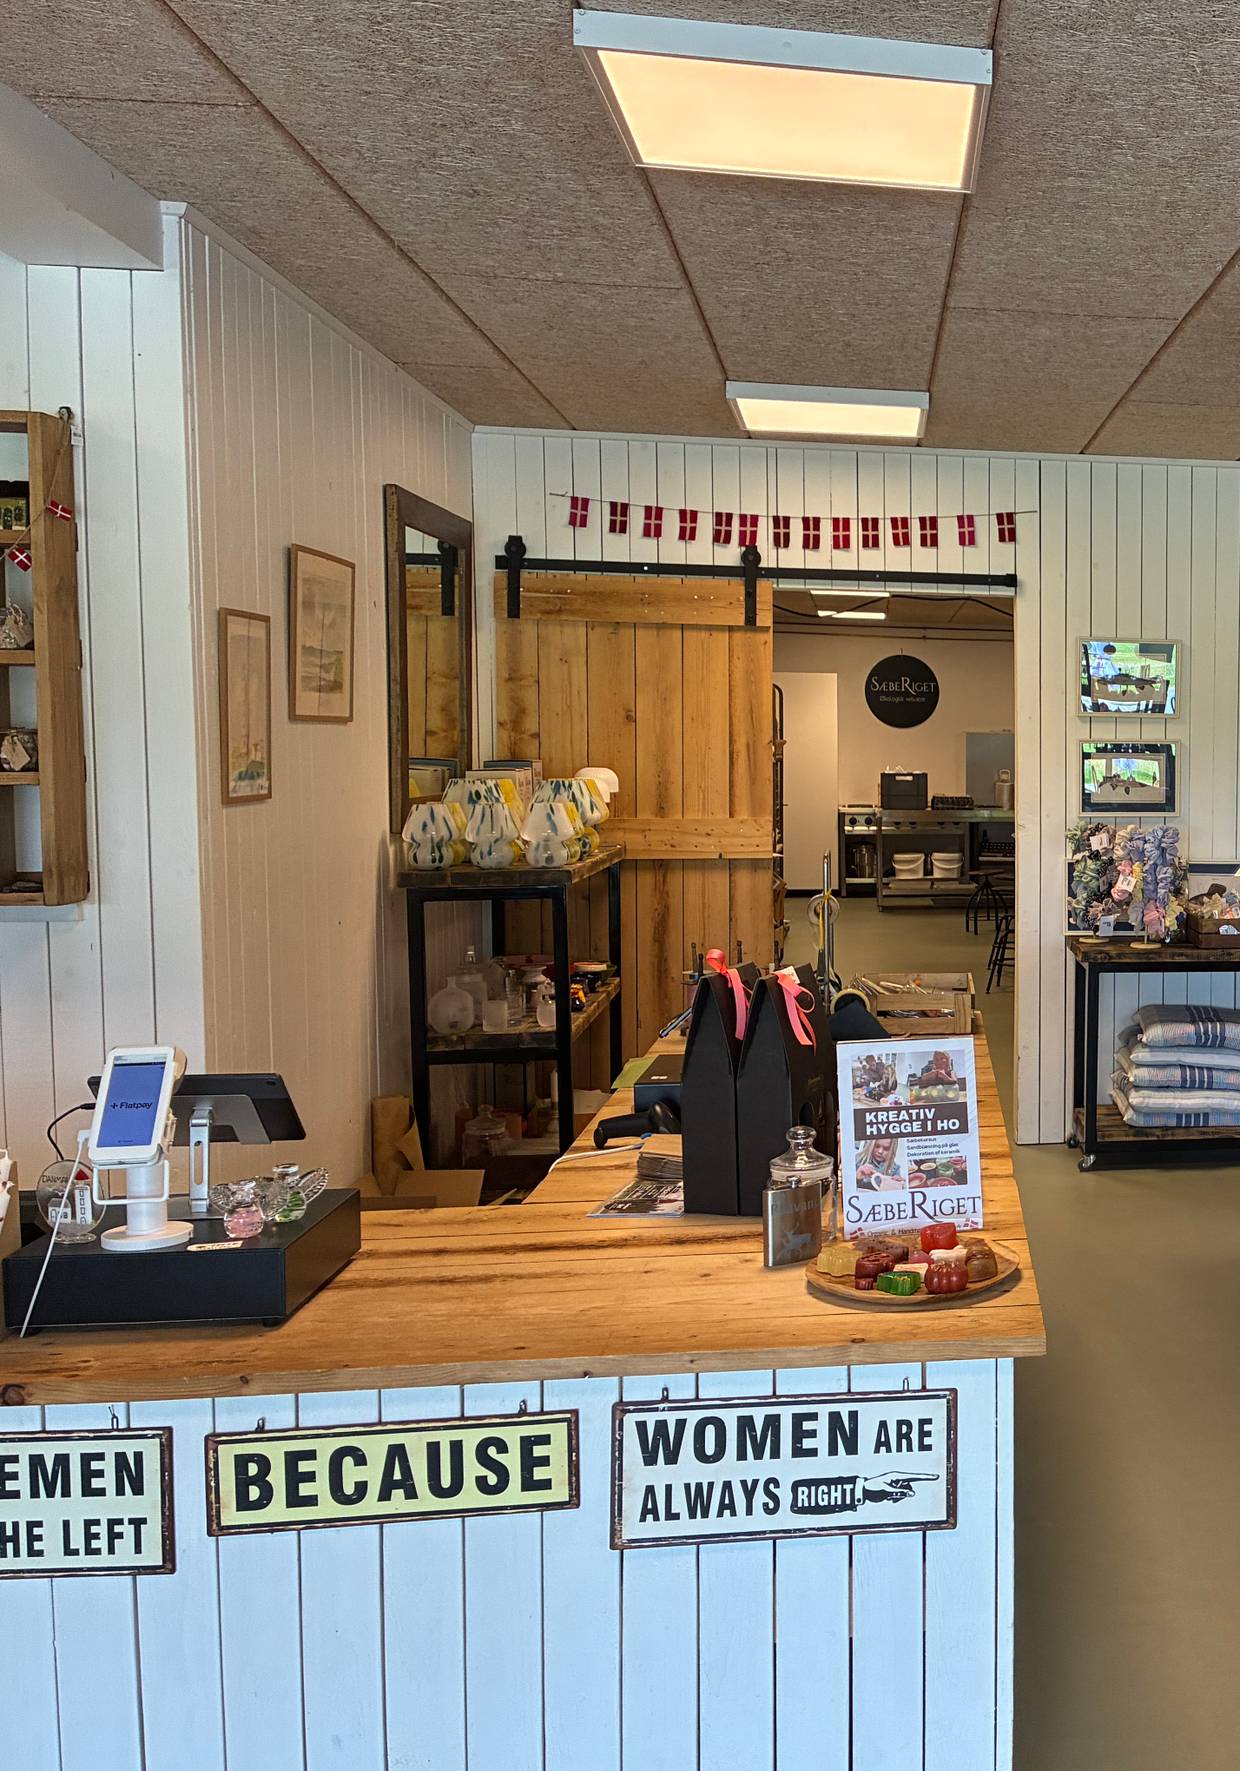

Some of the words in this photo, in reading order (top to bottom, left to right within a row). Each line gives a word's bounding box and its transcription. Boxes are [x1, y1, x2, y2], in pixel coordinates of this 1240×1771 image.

[119, 1101, 152, 1110] Flatpay
[865, 1108, 935, 1123] KREATIV
[866, 1121, 923, 1136] HYGGE
[927, 1121, 932, 1132] I
[937, 1119, 960, 1130] HO
[635, 1410, 859, 1467] WOMEN
[873, 1418, 933, 1454] ARE
[233, 1433, 552, 1512] BECAUSE
[639, 1477, 781, 1523] ALWAYS
[797, 1483, 854, 1507] RIGHT
[62, 1517, 148, 1557] LEFT
